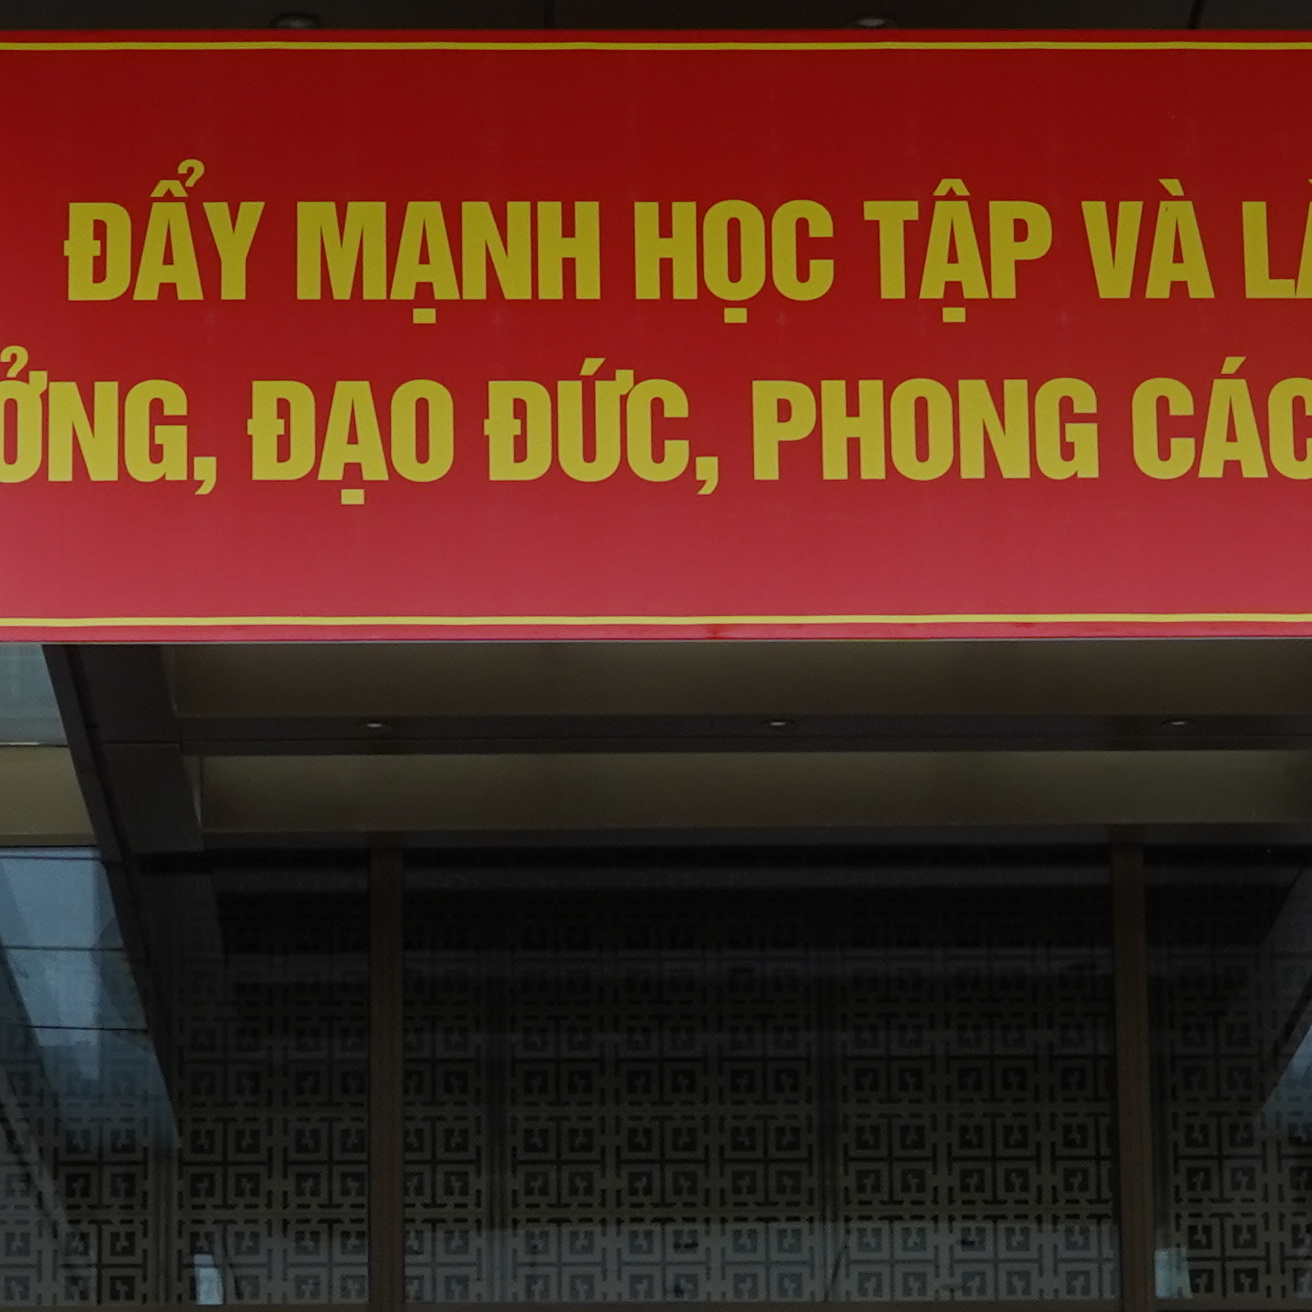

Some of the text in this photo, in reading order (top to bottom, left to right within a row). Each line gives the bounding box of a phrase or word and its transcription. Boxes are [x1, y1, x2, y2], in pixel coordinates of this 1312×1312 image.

[64, 159, 264, 301] ĐẨY
[298, 202, 600, 324] MẠNH
[635, 200, 833, 324] HỌC
[864, 179, 1052, 323] TẬP
[1082, 179, 1213, 299] VÀ
[248, 380, 453, 505] ĐẠO
[484, 357, 717, 495] ĐỨC,
[753, 378, 1098, 482] PHONG
